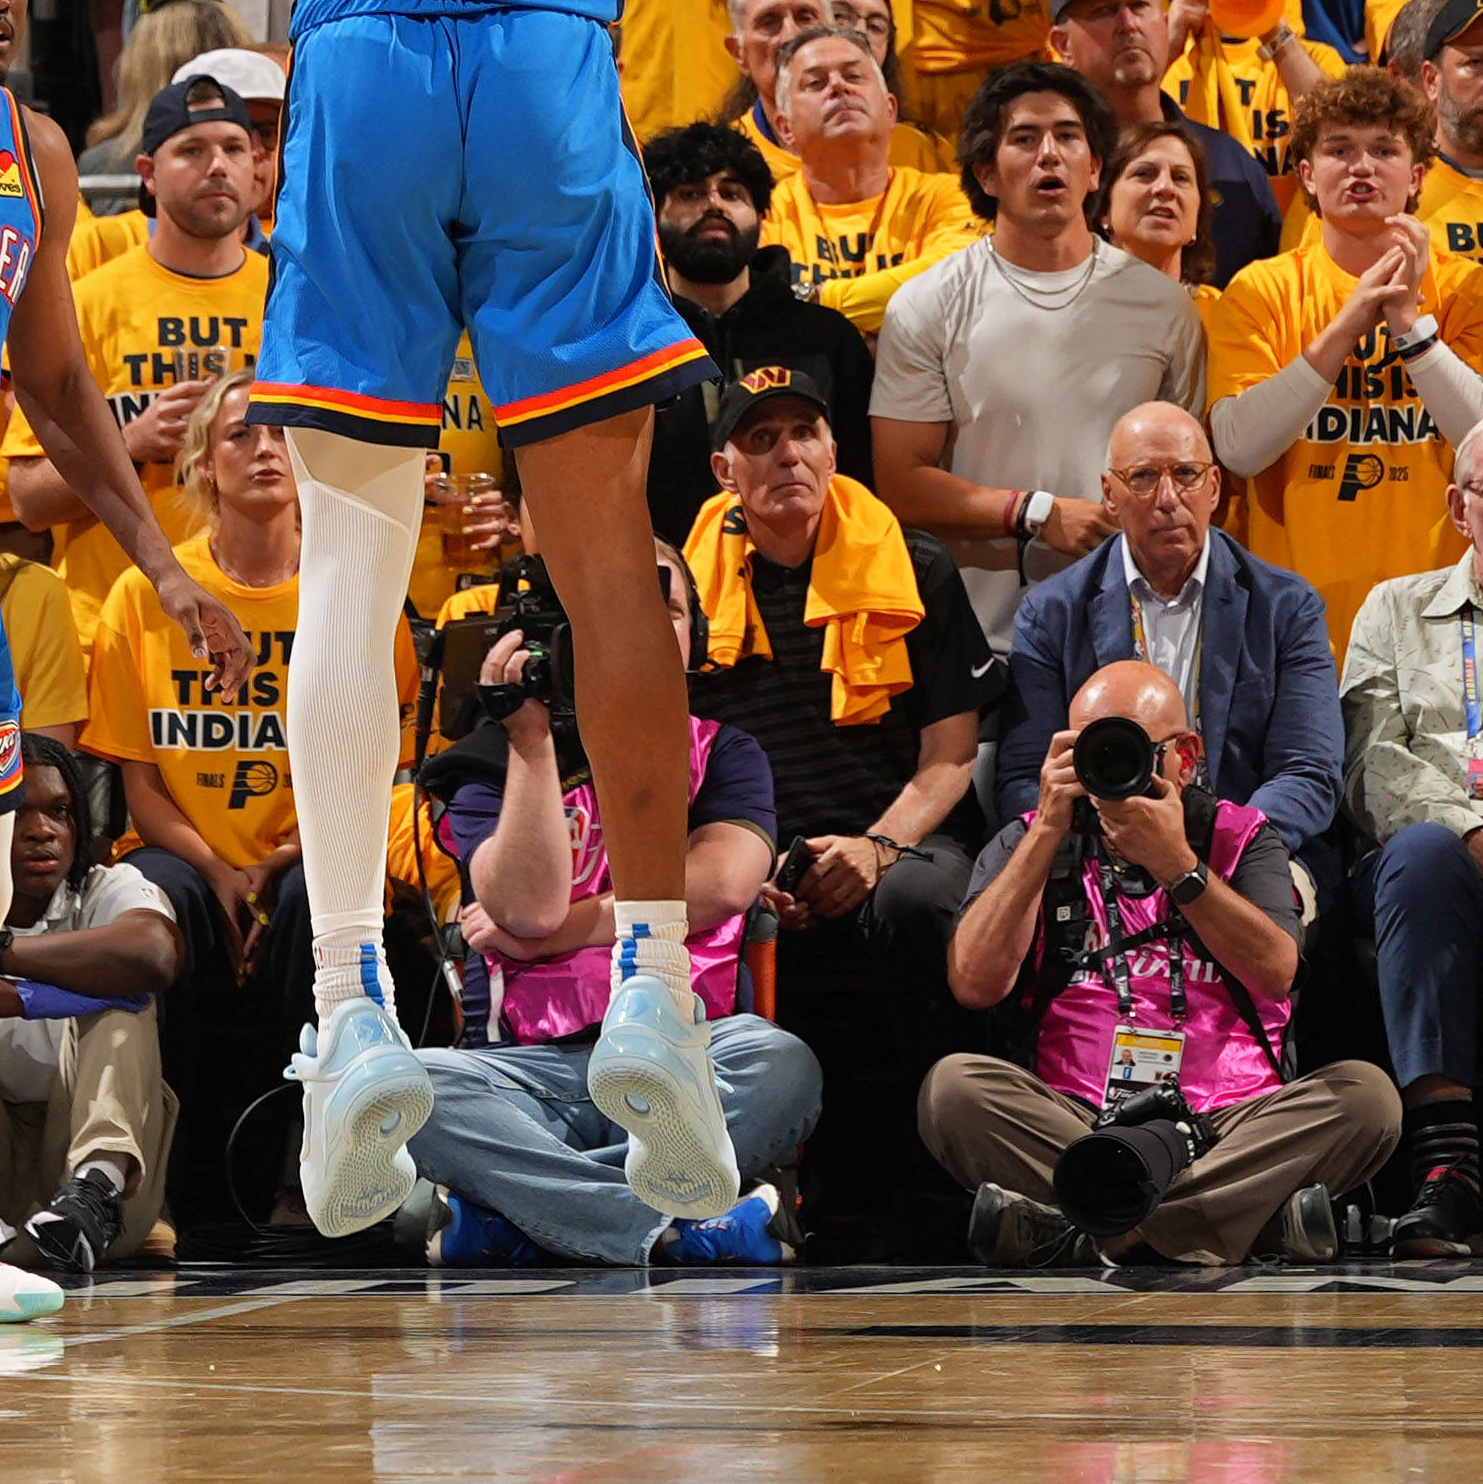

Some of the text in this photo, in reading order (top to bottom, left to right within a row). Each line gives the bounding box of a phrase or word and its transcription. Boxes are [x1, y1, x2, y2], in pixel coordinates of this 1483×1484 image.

[1252, 110, 1289, 137] IS
[157, 317, 248, 348] BUT
[122, 351, 227, 388] THIS
[1387, 465, 1409, 482] 2025
[171, 669, 280, 707] THIS
[150, 710, 289, 752] INDIA
[196, 772, 226, 791] FINALS
